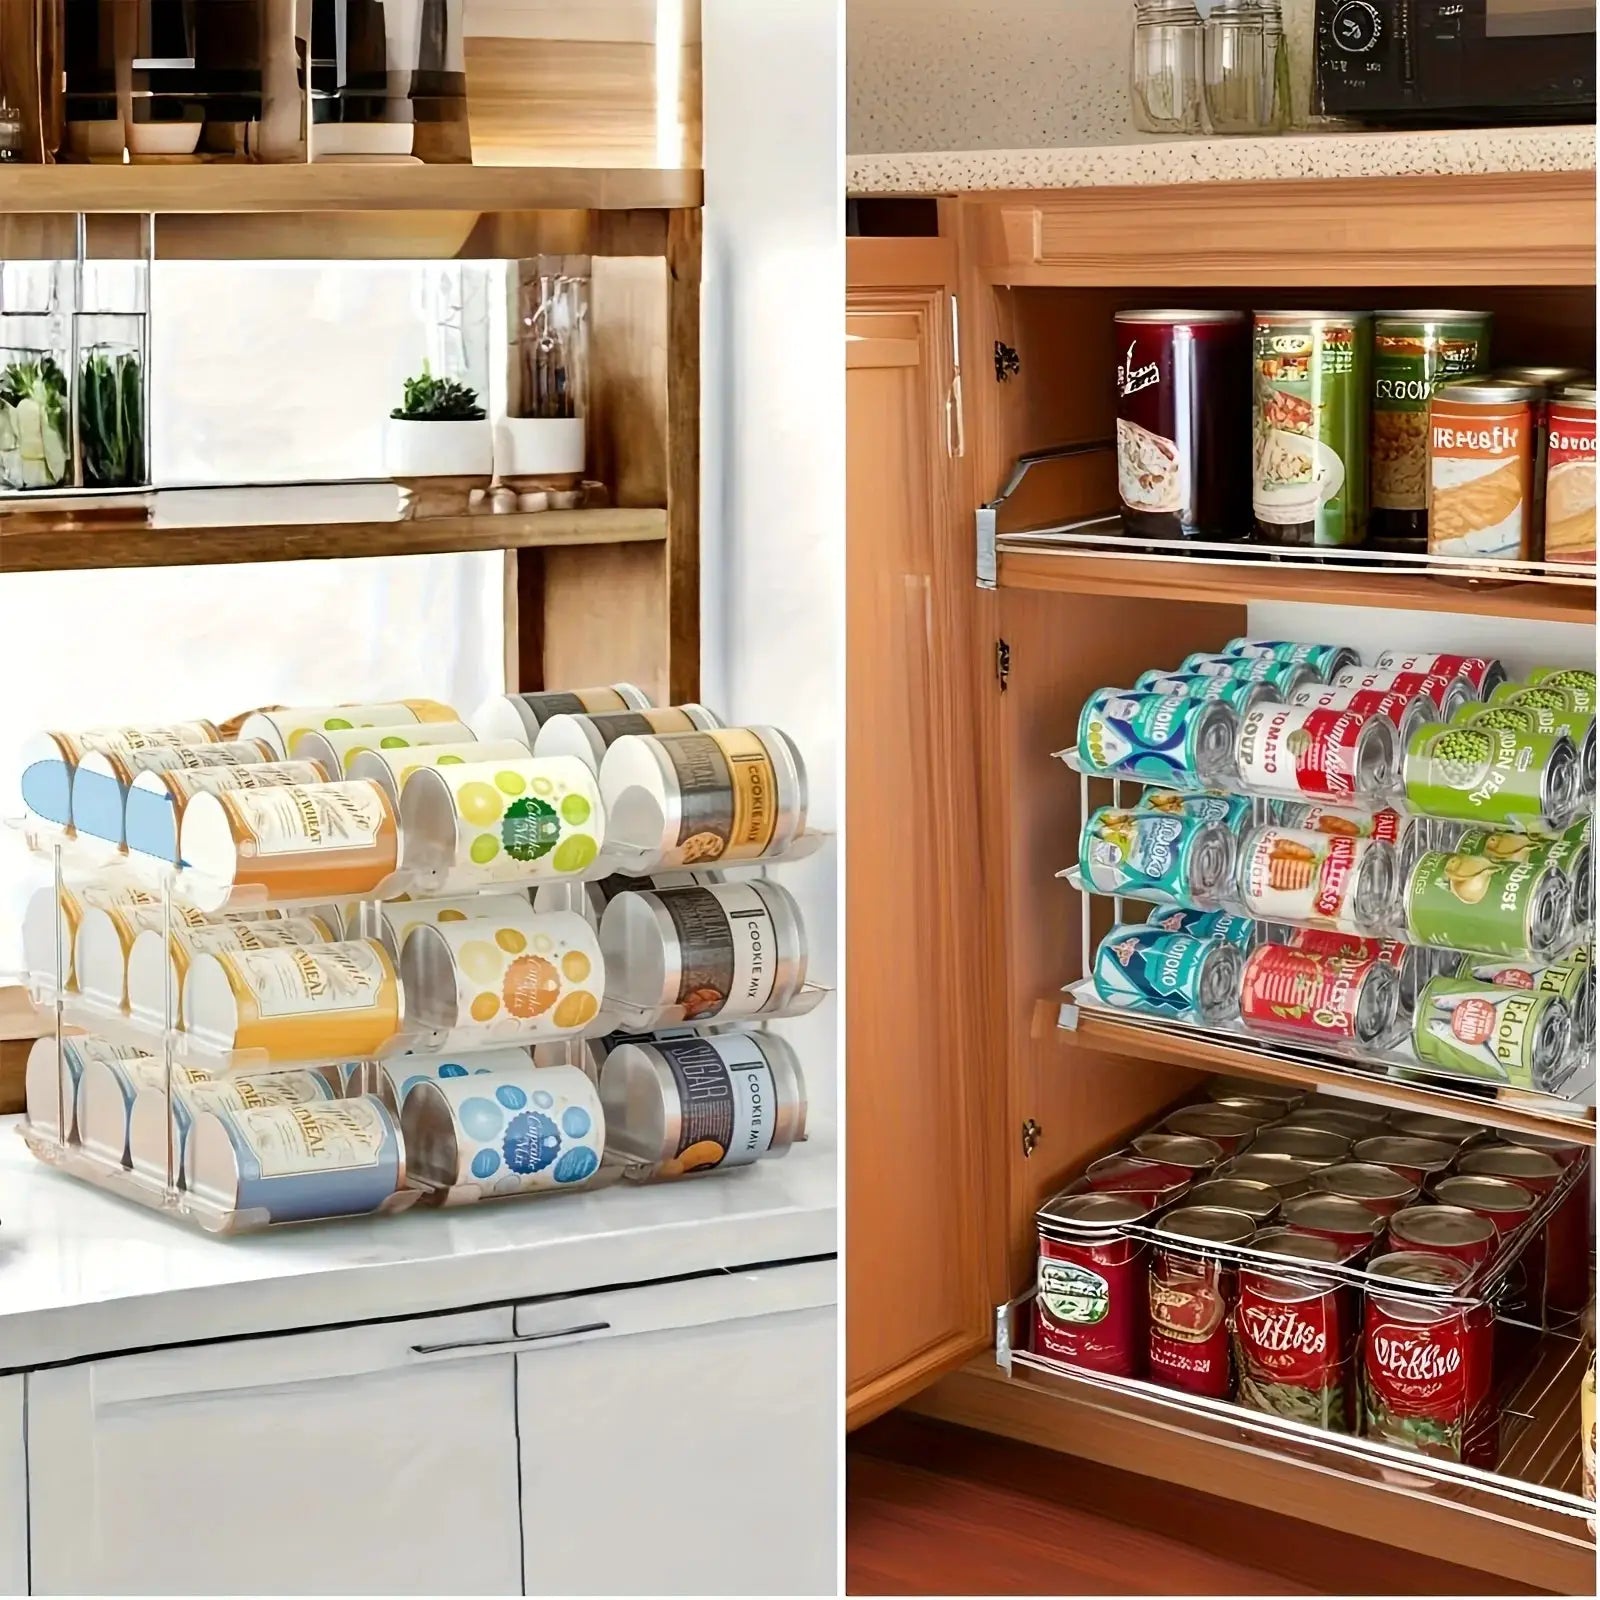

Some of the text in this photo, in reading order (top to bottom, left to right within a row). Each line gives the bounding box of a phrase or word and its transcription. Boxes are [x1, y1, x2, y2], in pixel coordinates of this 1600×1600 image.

[1240, 711, 1264, 765] SOUP
[1264, 711, 1291, 773] TOMATO
[748, 765, 763, 818] COOKIE
[1468, 770, 1507, 807] PEAS
[302, 800, 322, 845] WHEAT
[747, 921, 763, 999] COOKIE MIX
[1459, 1000, 1485, 1042] SALMON
[1497, 1000, 1533, 1059] Edola
[671, 1046, 729, 1100] SUGAR
[747, 1073, 762, 1151] COOKIE MIX
[514, 1137, 530, 1167] Mix
[527, 1115, 542, 1170] Cupcake
